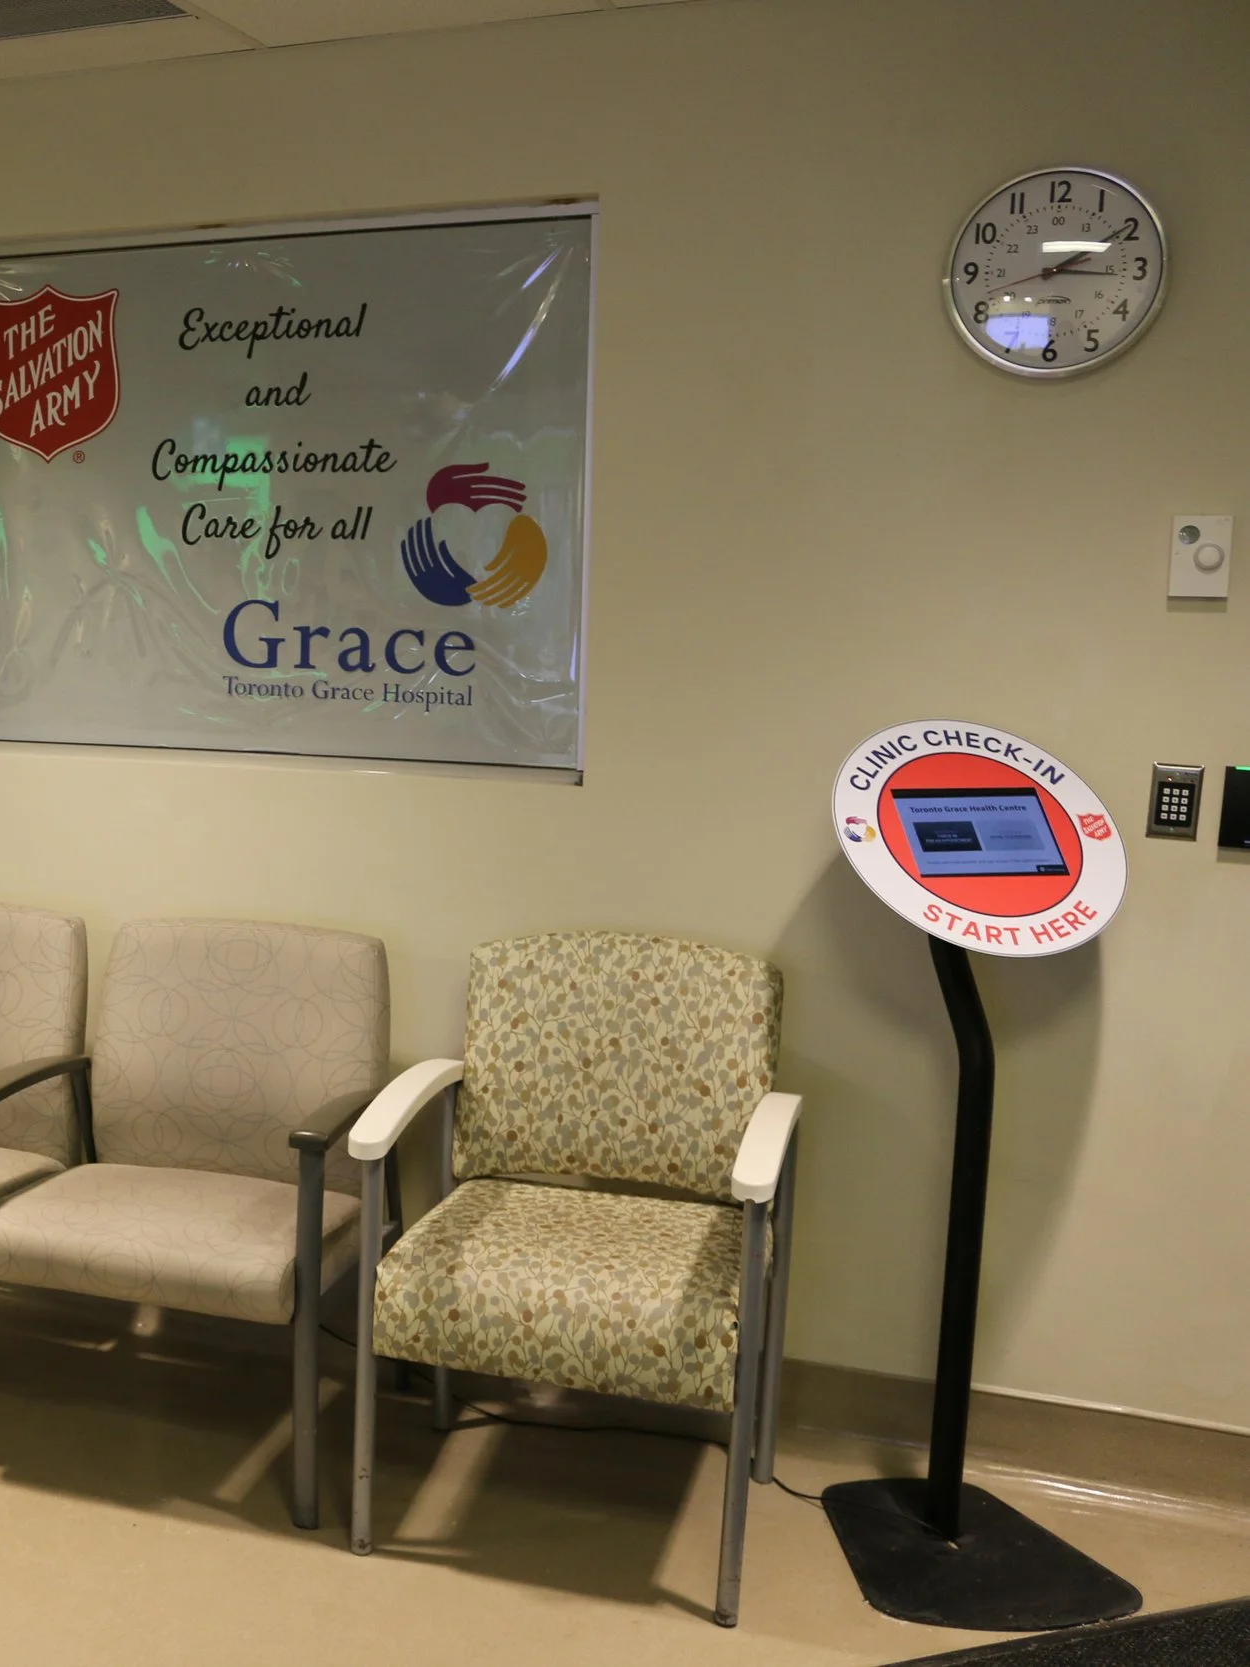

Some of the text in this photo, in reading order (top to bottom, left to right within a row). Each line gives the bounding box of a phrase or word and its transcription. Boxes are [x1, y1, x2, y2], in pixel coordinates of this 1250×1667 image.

[1010, 192, 1025, 214] 11
[1050, 180, 1072, 203] 12
[1098, 189, 1105, 213] 1
[975, 222, 997, 245] 10
[1026, 225, 1039, 235] 23
[1081, 223, 1091, 233] 13
[1123, 217, 1140, 241] 2
[1006, 244, 1019, 254] 22
[964, 261, 979, 285] 9
[996, 268, 1006, 278] 21
[1132, 256, 1148, 281] 3
[1094, 291, 1104, 300] 16
[973, 301, 989, 324] 8
[1075, 309, 1084, 319] 17
[1113, 298, 1130, 322] 4
[3, 304, 56, 360] THE
[178, 302, 367, 359] Exceptional
[1004, 331, 1020, 353] 7
[1084, 329, 1100, 352] 5
[1042, 339, 1057, 362] 6
[29, 360, 101, 438] ARMY
[245, 371, 312, 407] and
[151, 438, 398, 491] Compassionate
[181, 502, 373, 559] Care for all
[223, 599, 476, 677] Grace
[222, 675, 473, 712] Toronto Grace Hospital
[849, 729, 1065, 792] CLINIC CHECK-IN
[922, 900, 1098, 946] START HERE
